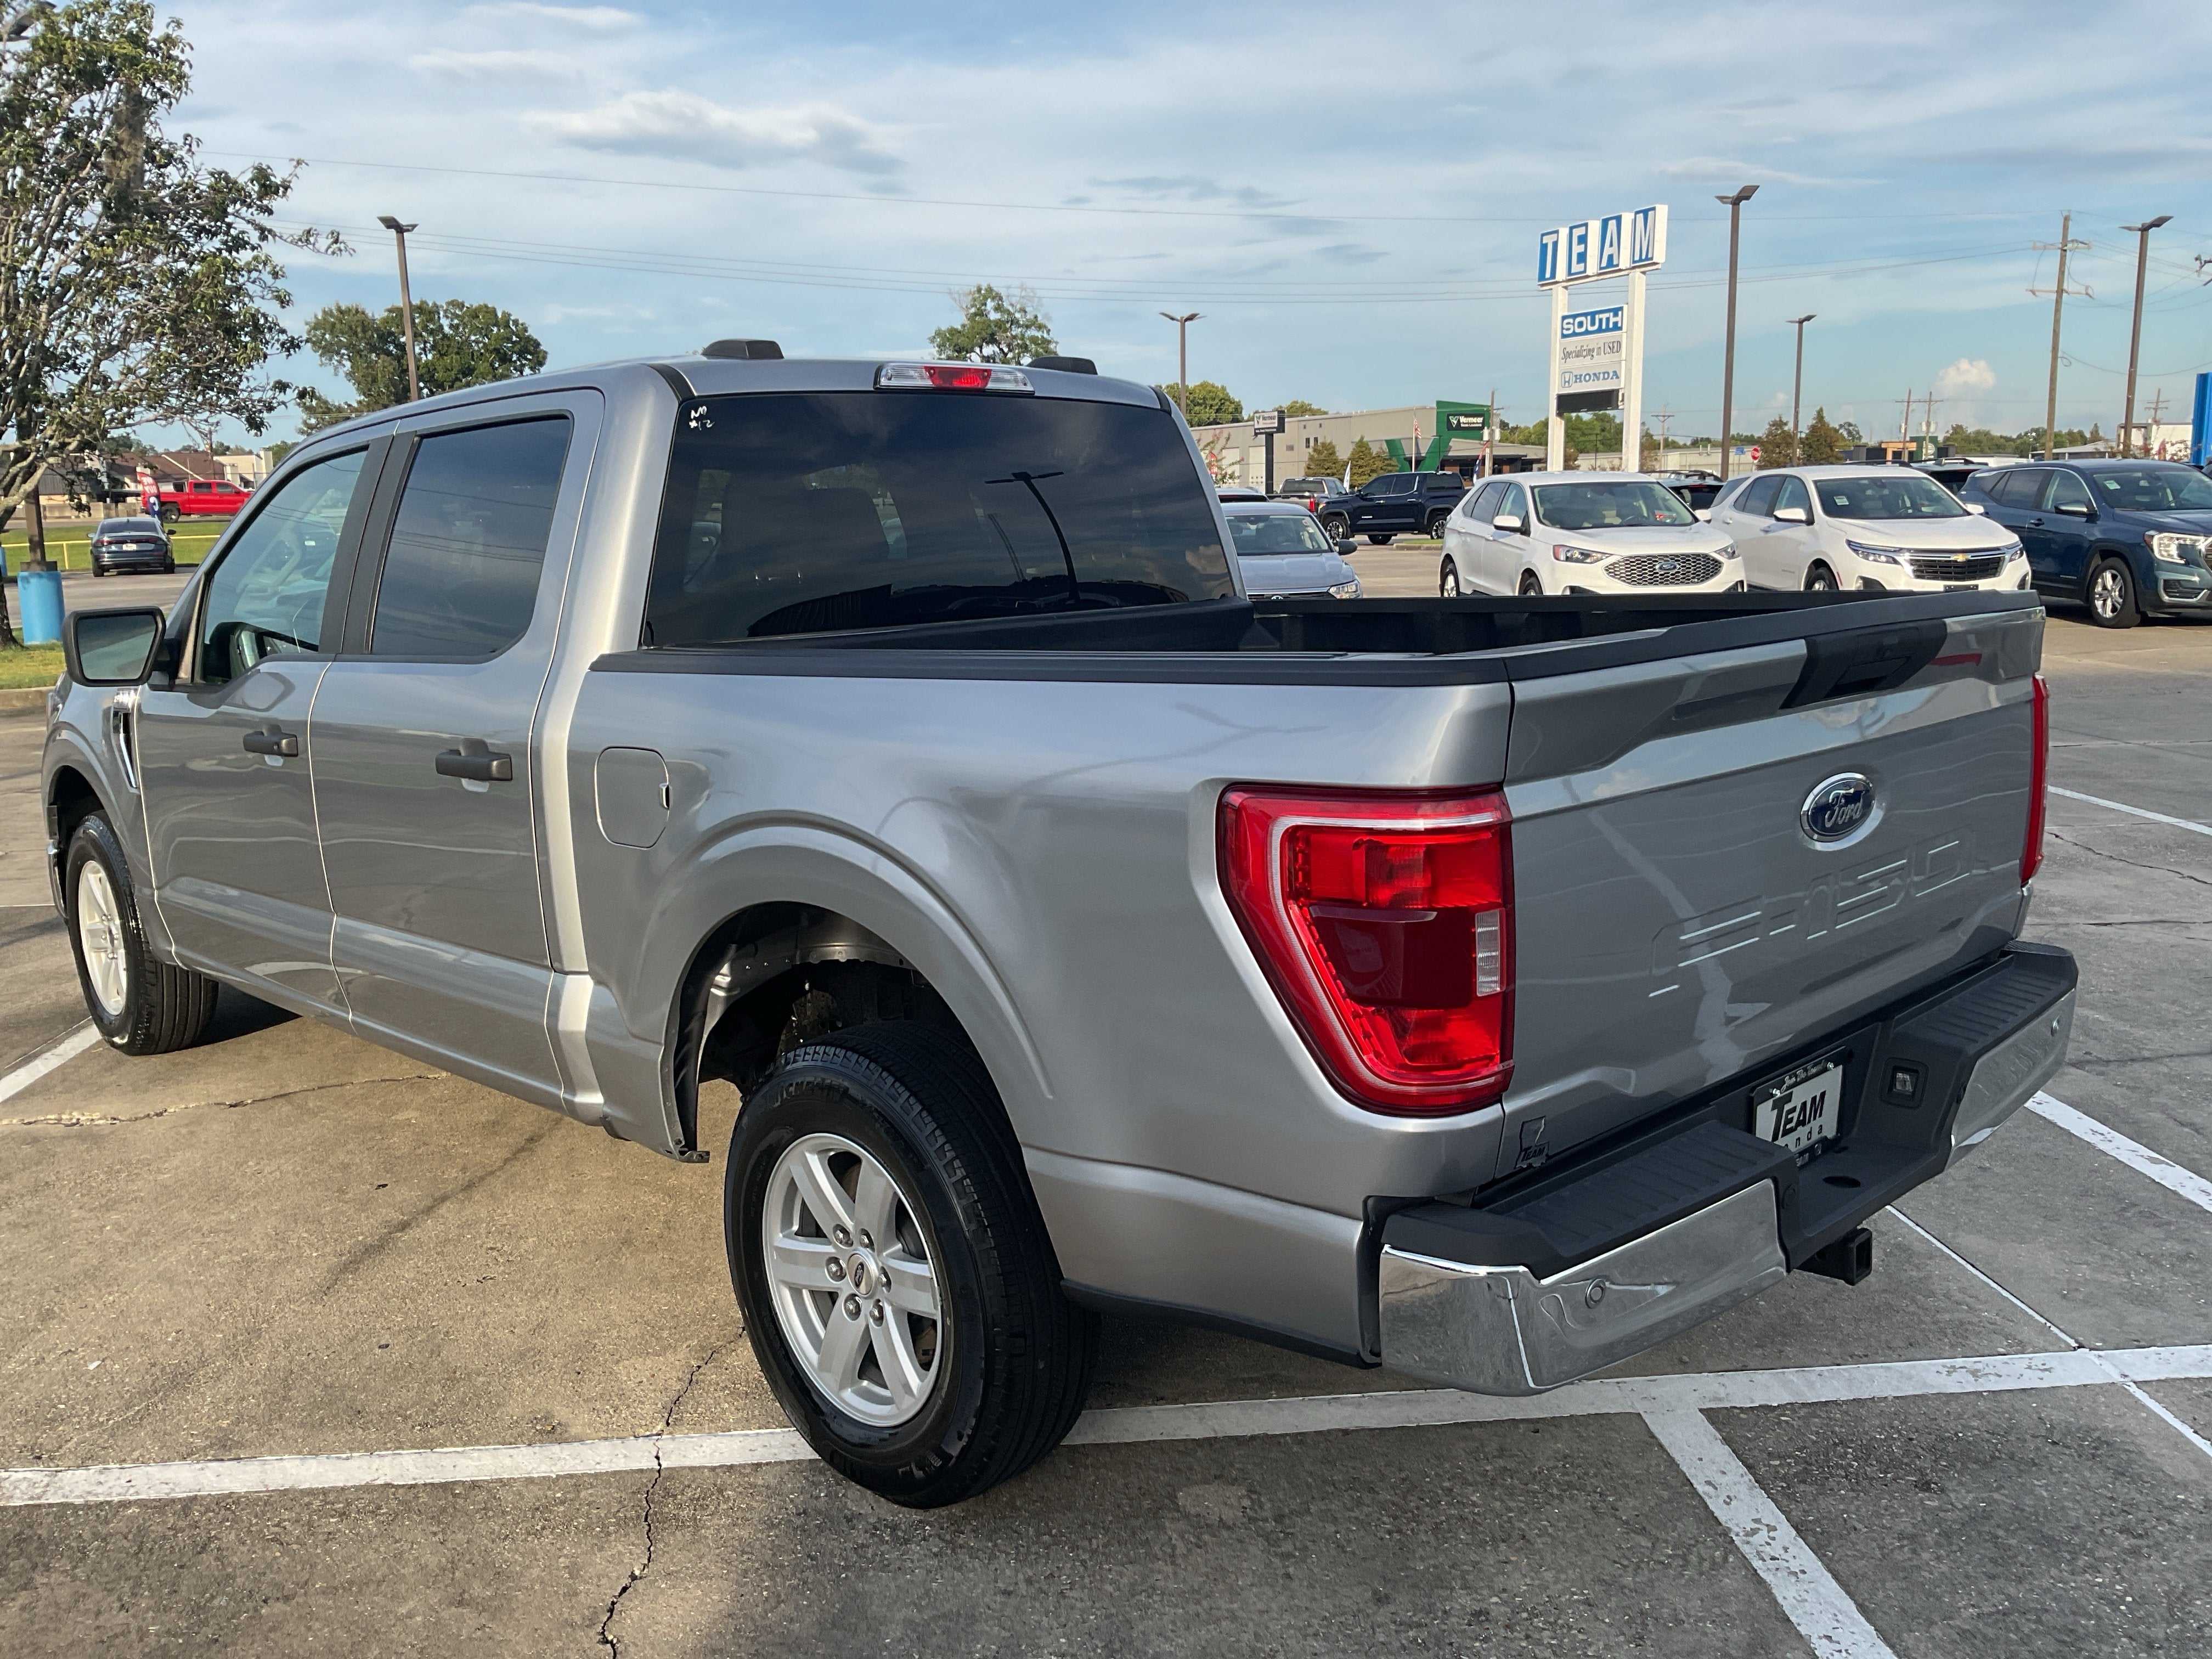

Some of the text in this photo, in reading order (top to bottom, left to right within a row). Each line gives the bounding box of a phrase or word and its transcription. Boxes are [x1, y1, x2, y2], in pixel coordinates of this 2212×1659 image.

[1542, 210, 1655, 279] TEAM
[1562, 311, 1622, 335] SOUTH
[1561, 340, 1621, 363] Specializing in USED
[1573, 370, 1620, 383] HONDA
[1825, 788, 1865, 828] Ford
[1649, 824, 1974, 997] F-150
[1770, 1090, 1826, 1142] TEAM
[1521, 1146, 1546, 1163] TEAM
